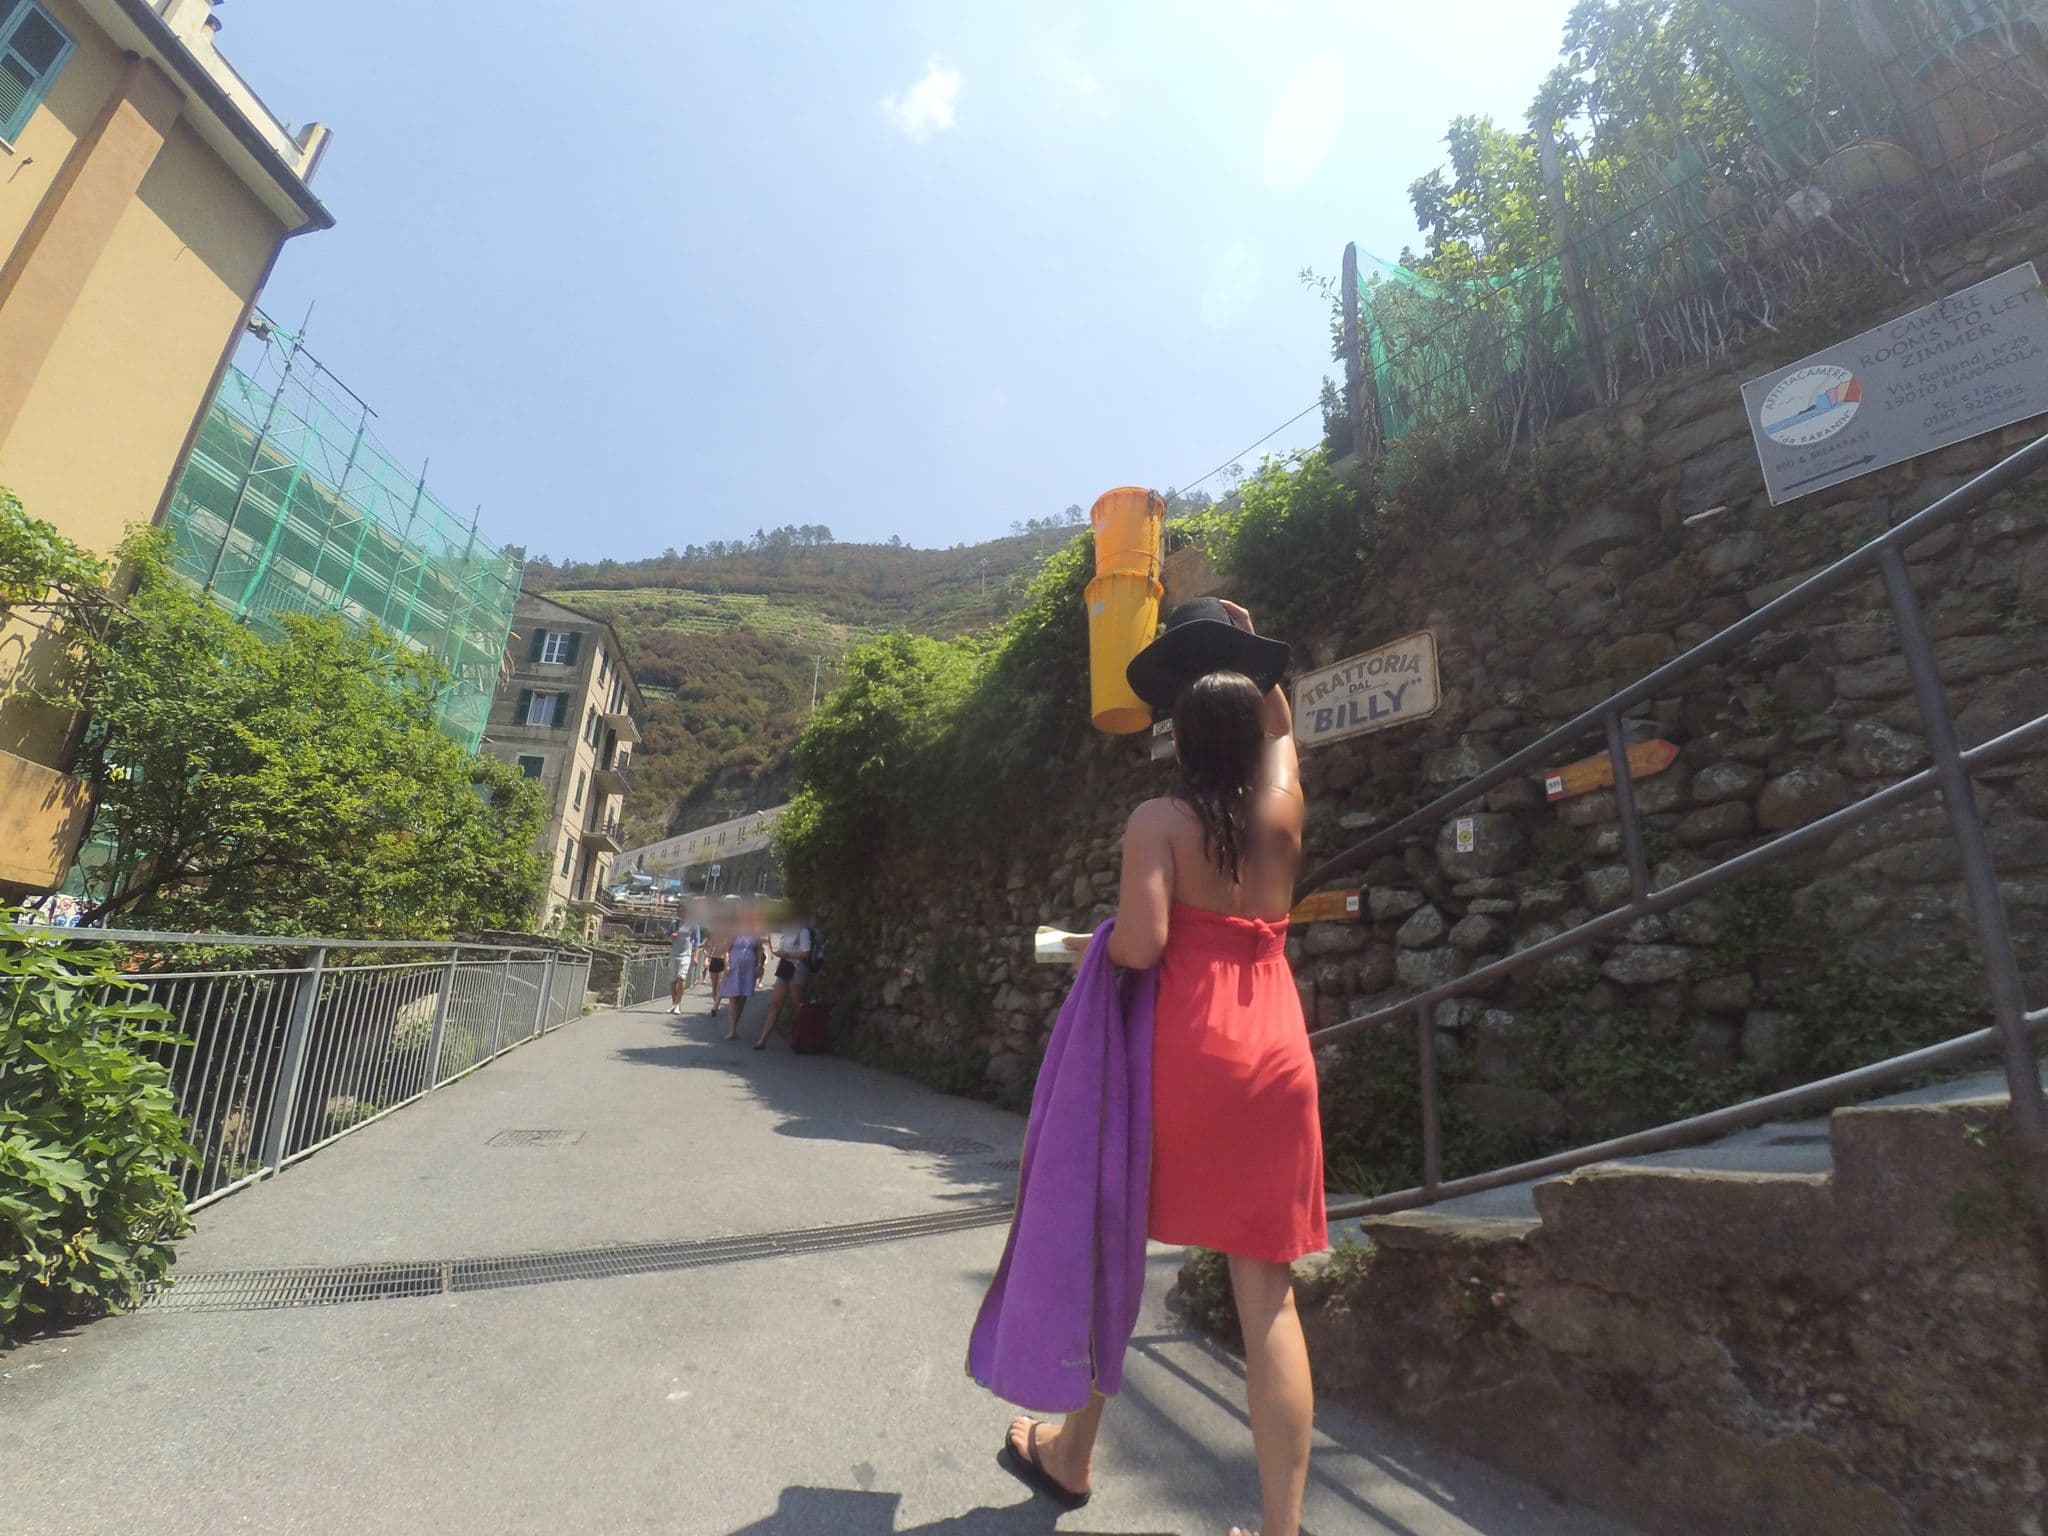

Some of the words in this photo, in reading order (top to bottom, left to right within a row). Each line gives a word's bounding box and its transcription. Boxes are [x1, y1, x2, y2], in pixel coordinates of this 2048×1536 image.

[1860, 328, 1942, 369] ROOMS
[1947, 311, 1982, 332] TO
[1989, 288, 2032, 316] LET
[1890, 292, 1985, 339] CAMERE
[1902, 322, 1997, 369] ZIMMER
[1764, 367, 1848, 411] AFFITTACAMERE
[1885, 383, 1939, 411] 19010
[1943, 347, 2041, 389] MANAROLA
[1887, 381, 1915, 396] Via
[1302, 653, 1421, 706] TRATTORIA
[1349, 679, 1373, 694] DAL
[1305, 677, 1422, 734] "BILLY"
